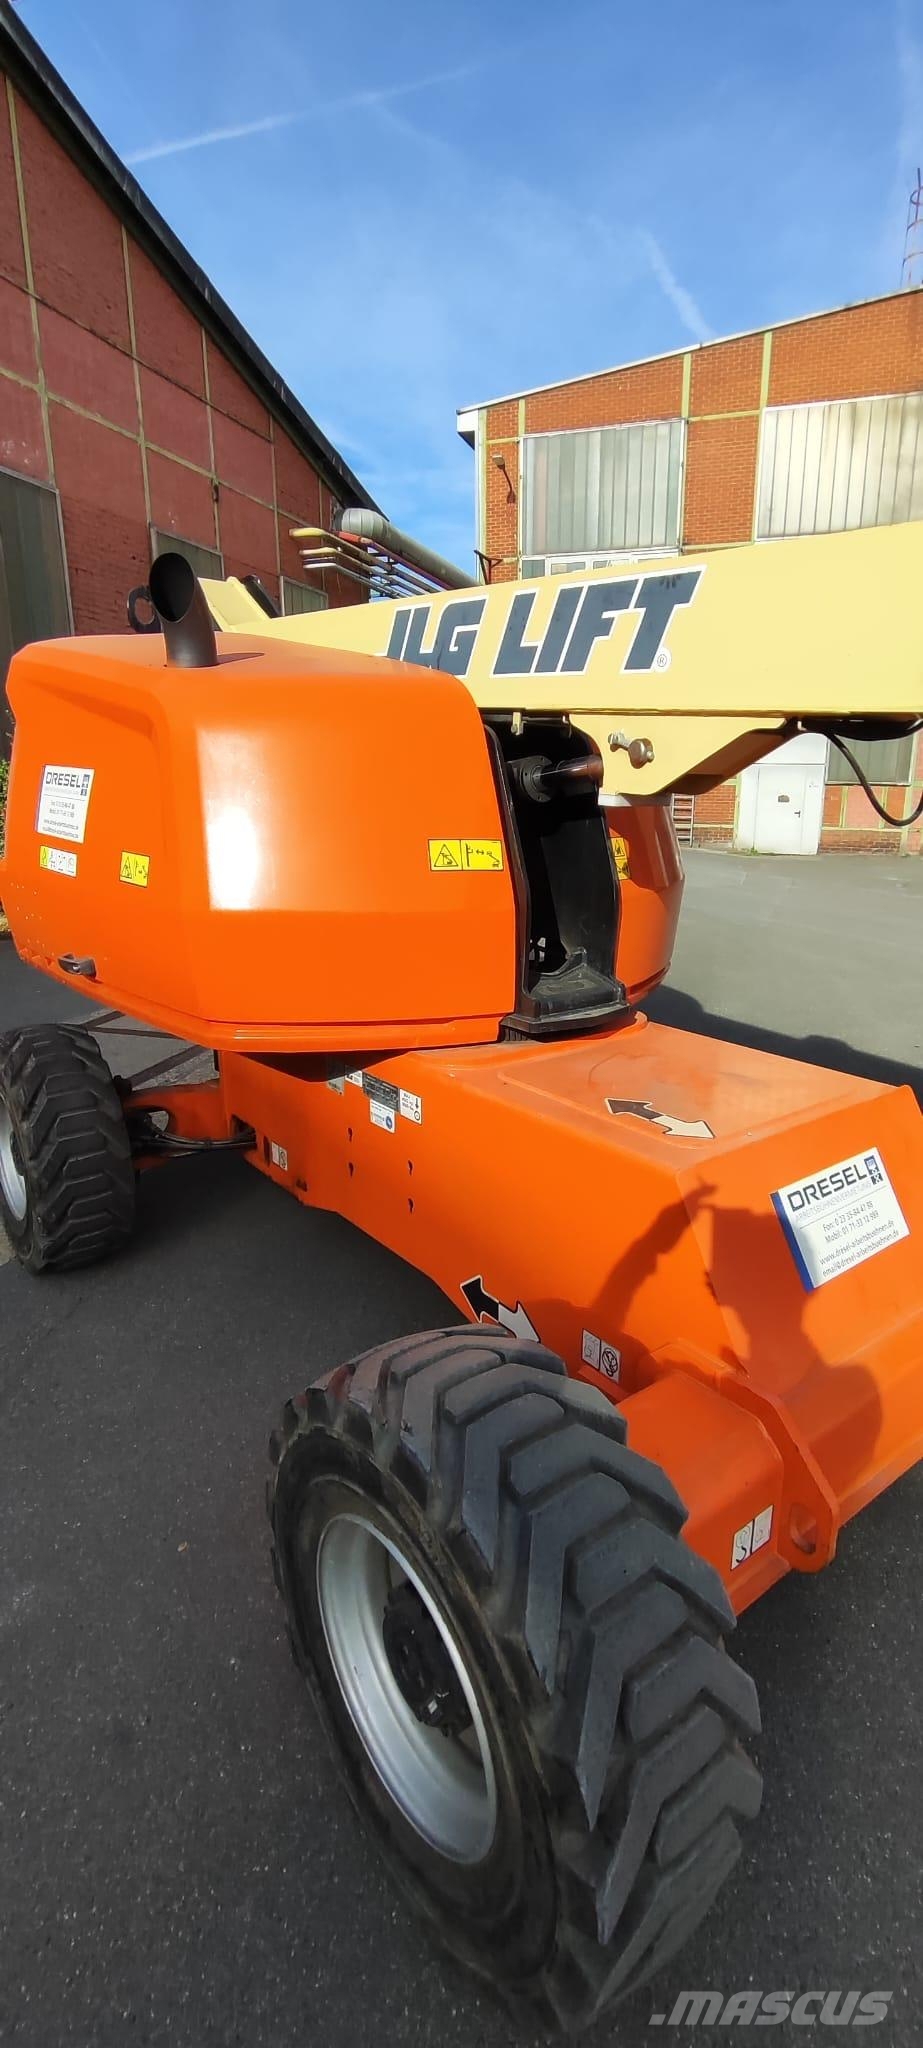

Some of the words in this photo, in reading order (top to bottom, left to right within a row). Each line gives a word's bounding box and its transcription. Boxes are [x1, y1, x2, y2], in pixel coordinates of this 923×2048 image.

[387, 598, 487, 676] JLG
[492, 570, 702, 675] LIFT
[45, 771, 81, 788] DRESEL
[787, 1164, 868, 1212] DRESEL
